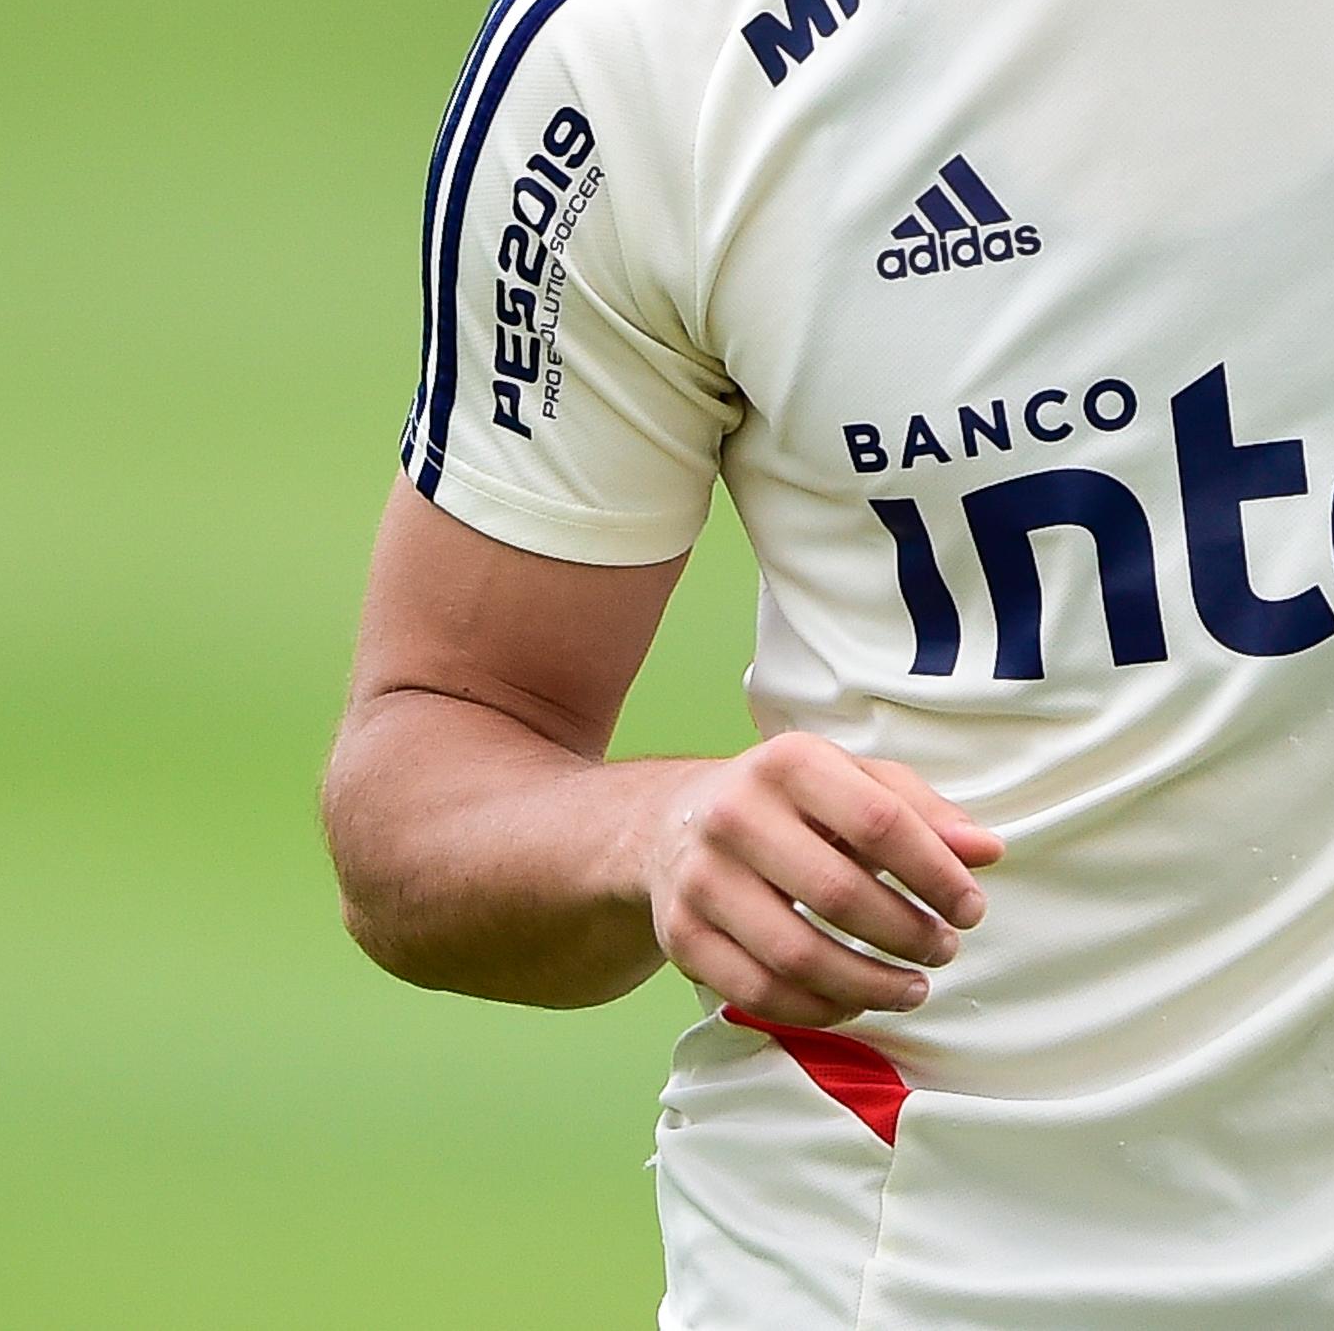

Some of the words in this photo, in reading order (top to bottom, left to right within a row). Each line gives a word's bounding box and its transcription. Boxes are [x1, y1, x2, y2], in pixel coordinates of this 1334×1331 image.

[550, 165, 606, 255] SOCCER
[876, 224, 1042, 280] adidas
[492, 106, 596, 441] PES2019
[539, 256, 567, 365] EOLUTIO
[542, 369, 562, 420] PRO
[842, 378, 1138, 473] BANCO
